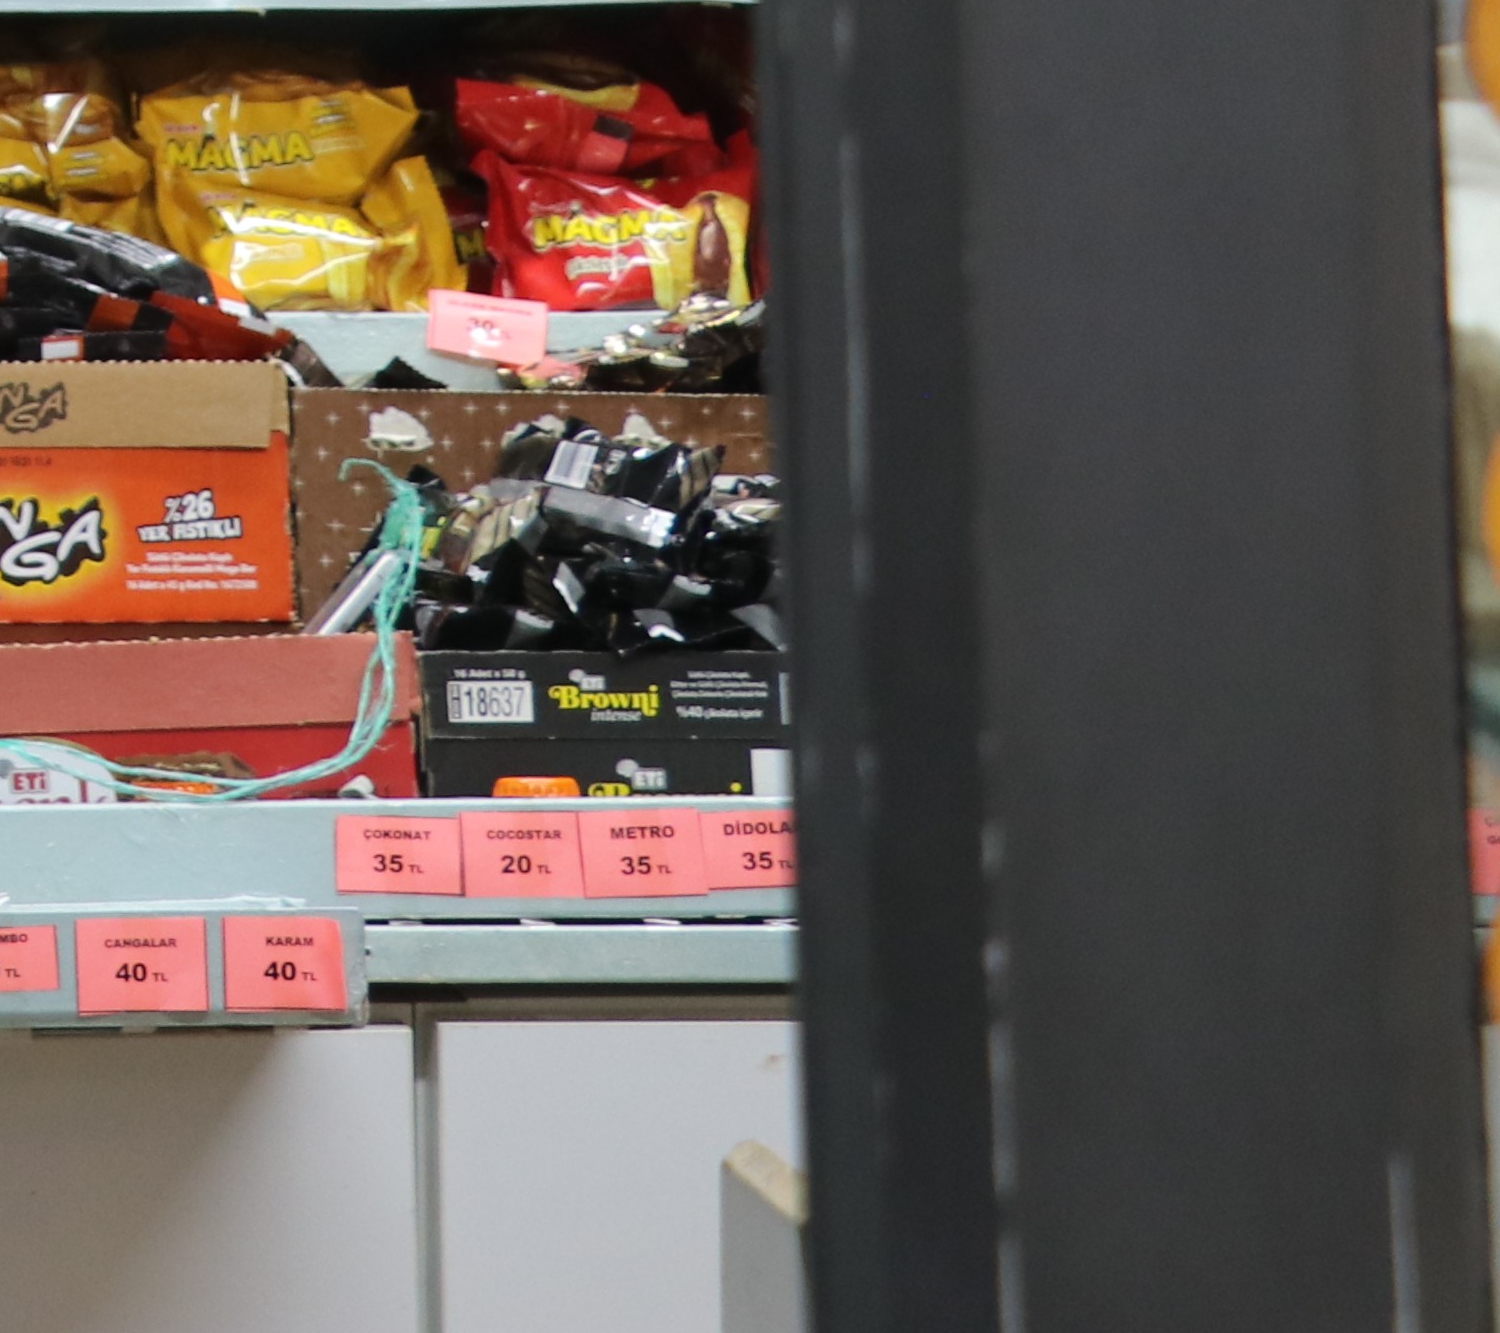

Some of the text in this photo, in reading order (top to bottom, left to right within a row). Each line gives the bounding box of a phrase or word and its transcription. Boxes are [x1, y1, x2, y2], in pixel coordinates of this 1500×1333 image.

[166, 134, 314, 172] MAGMA
[533, 210, 686, 249] MAGMA
[164, 491, 215, 523] %26
[138, 525, 170, 542] YER
[464, 686, 525, 717] 18637
[549, 685, 659, 716] Browni
[591, 708, 642, 722] intense
[364, 829, 431, 841] ÇOKONAT
[486, 829, 561, 840] COCOSTAR
[610, 826, 674, 839] METRO
[373, 854, 423, 874] 35 TL
[501, 856, 551, 874] 20 TL
[621, 856, 672, 875] 35 TL
[742, 853, 772, 870] 35
[104, 937, 177, 949] CANGALAR
[265, 937, 314, 947] KARAM
[5, 968, 20, 978] TL
[116, 963, 168, 982] 40 TL
[264, 962, 317, 981] 40 TL
